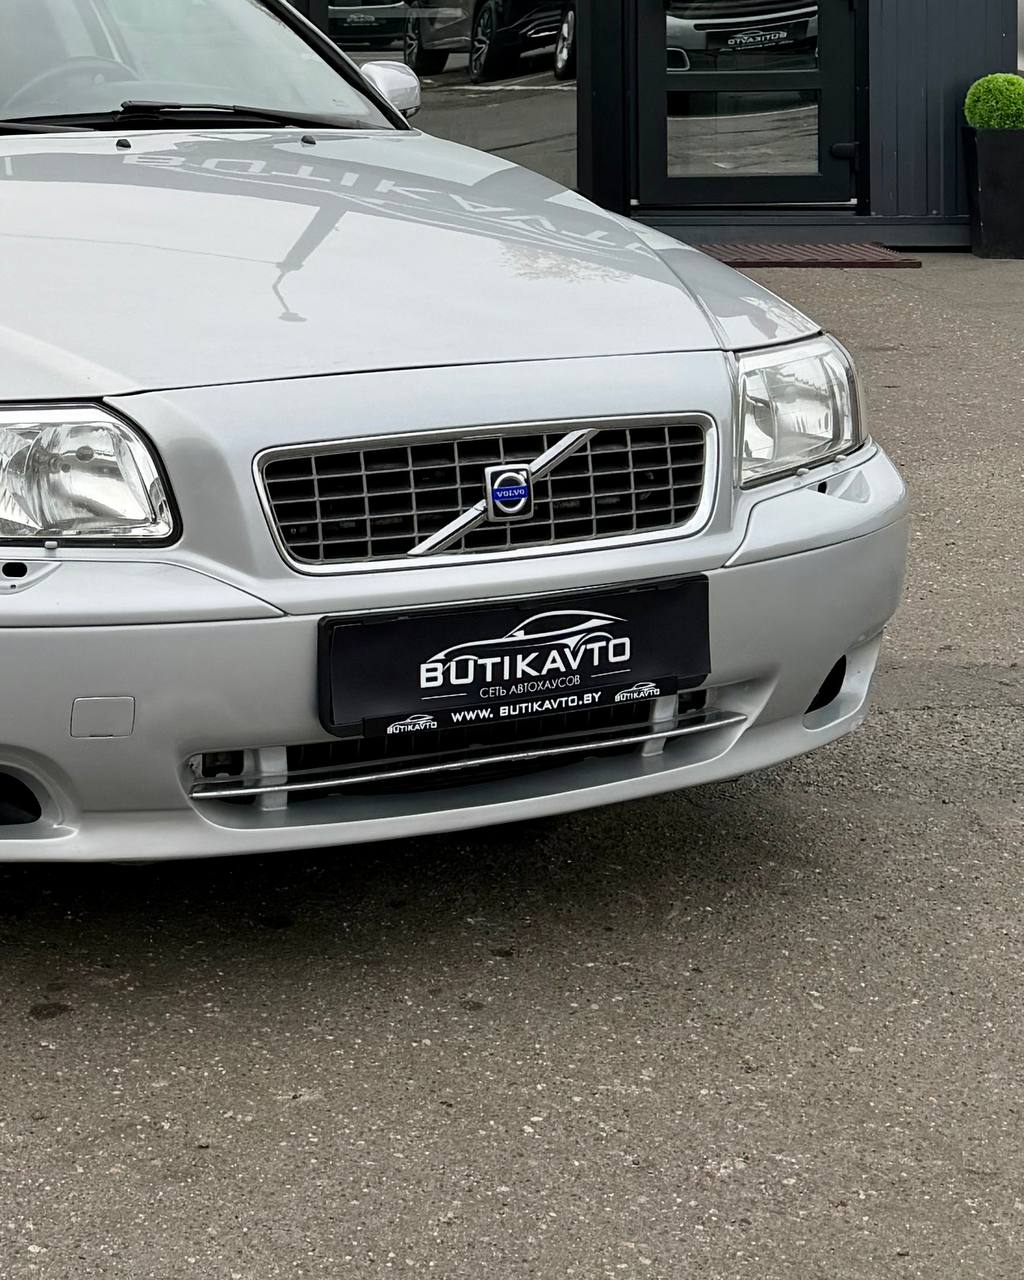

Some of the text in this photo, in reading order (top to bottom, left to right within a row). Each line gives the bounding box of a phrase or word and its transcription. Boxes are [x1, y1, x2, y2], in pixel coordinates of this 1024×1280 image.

[495, 488, 525, 498] VOLVO
[420, 636, 631, 689] BUTIKAVTO
[479, 675, 581, 699] СЕТЬ АВТОХАУСОВ
[614, 688, 661, 703] BUTIKAVTO
[386, 721, 438, 734] BUTIKAVTO
